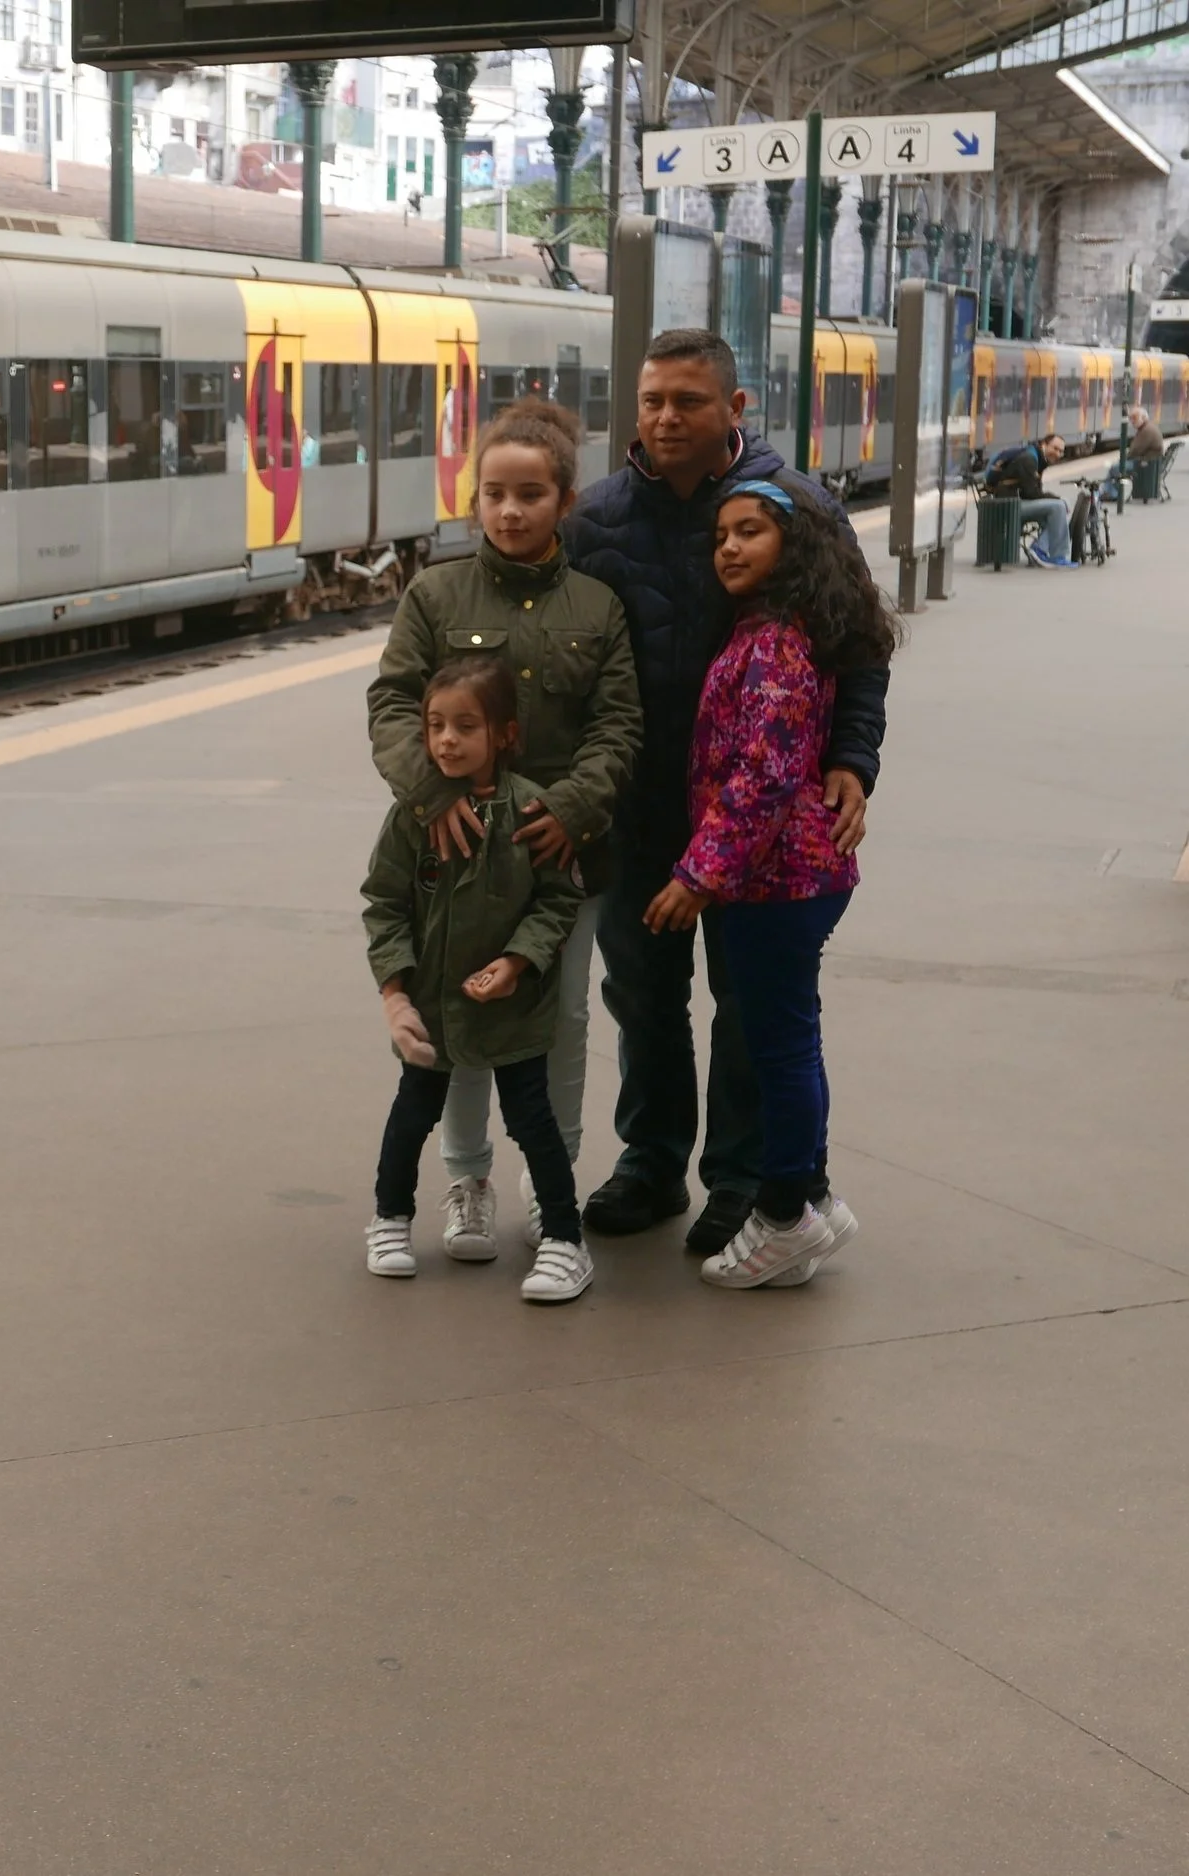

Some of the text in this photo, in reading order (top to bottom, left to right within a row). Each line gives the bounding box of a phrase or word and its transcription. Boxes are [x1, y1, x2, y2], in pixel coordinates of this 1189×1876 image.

[710, 137, 737, 146] Linha
[893, 126, 921, 135] Linha
[716, 147, 732, 172] 3
[767, 140, 790, 164] A
[838, 136, 861, 160] A
[897, 138, 916, 163] 4
